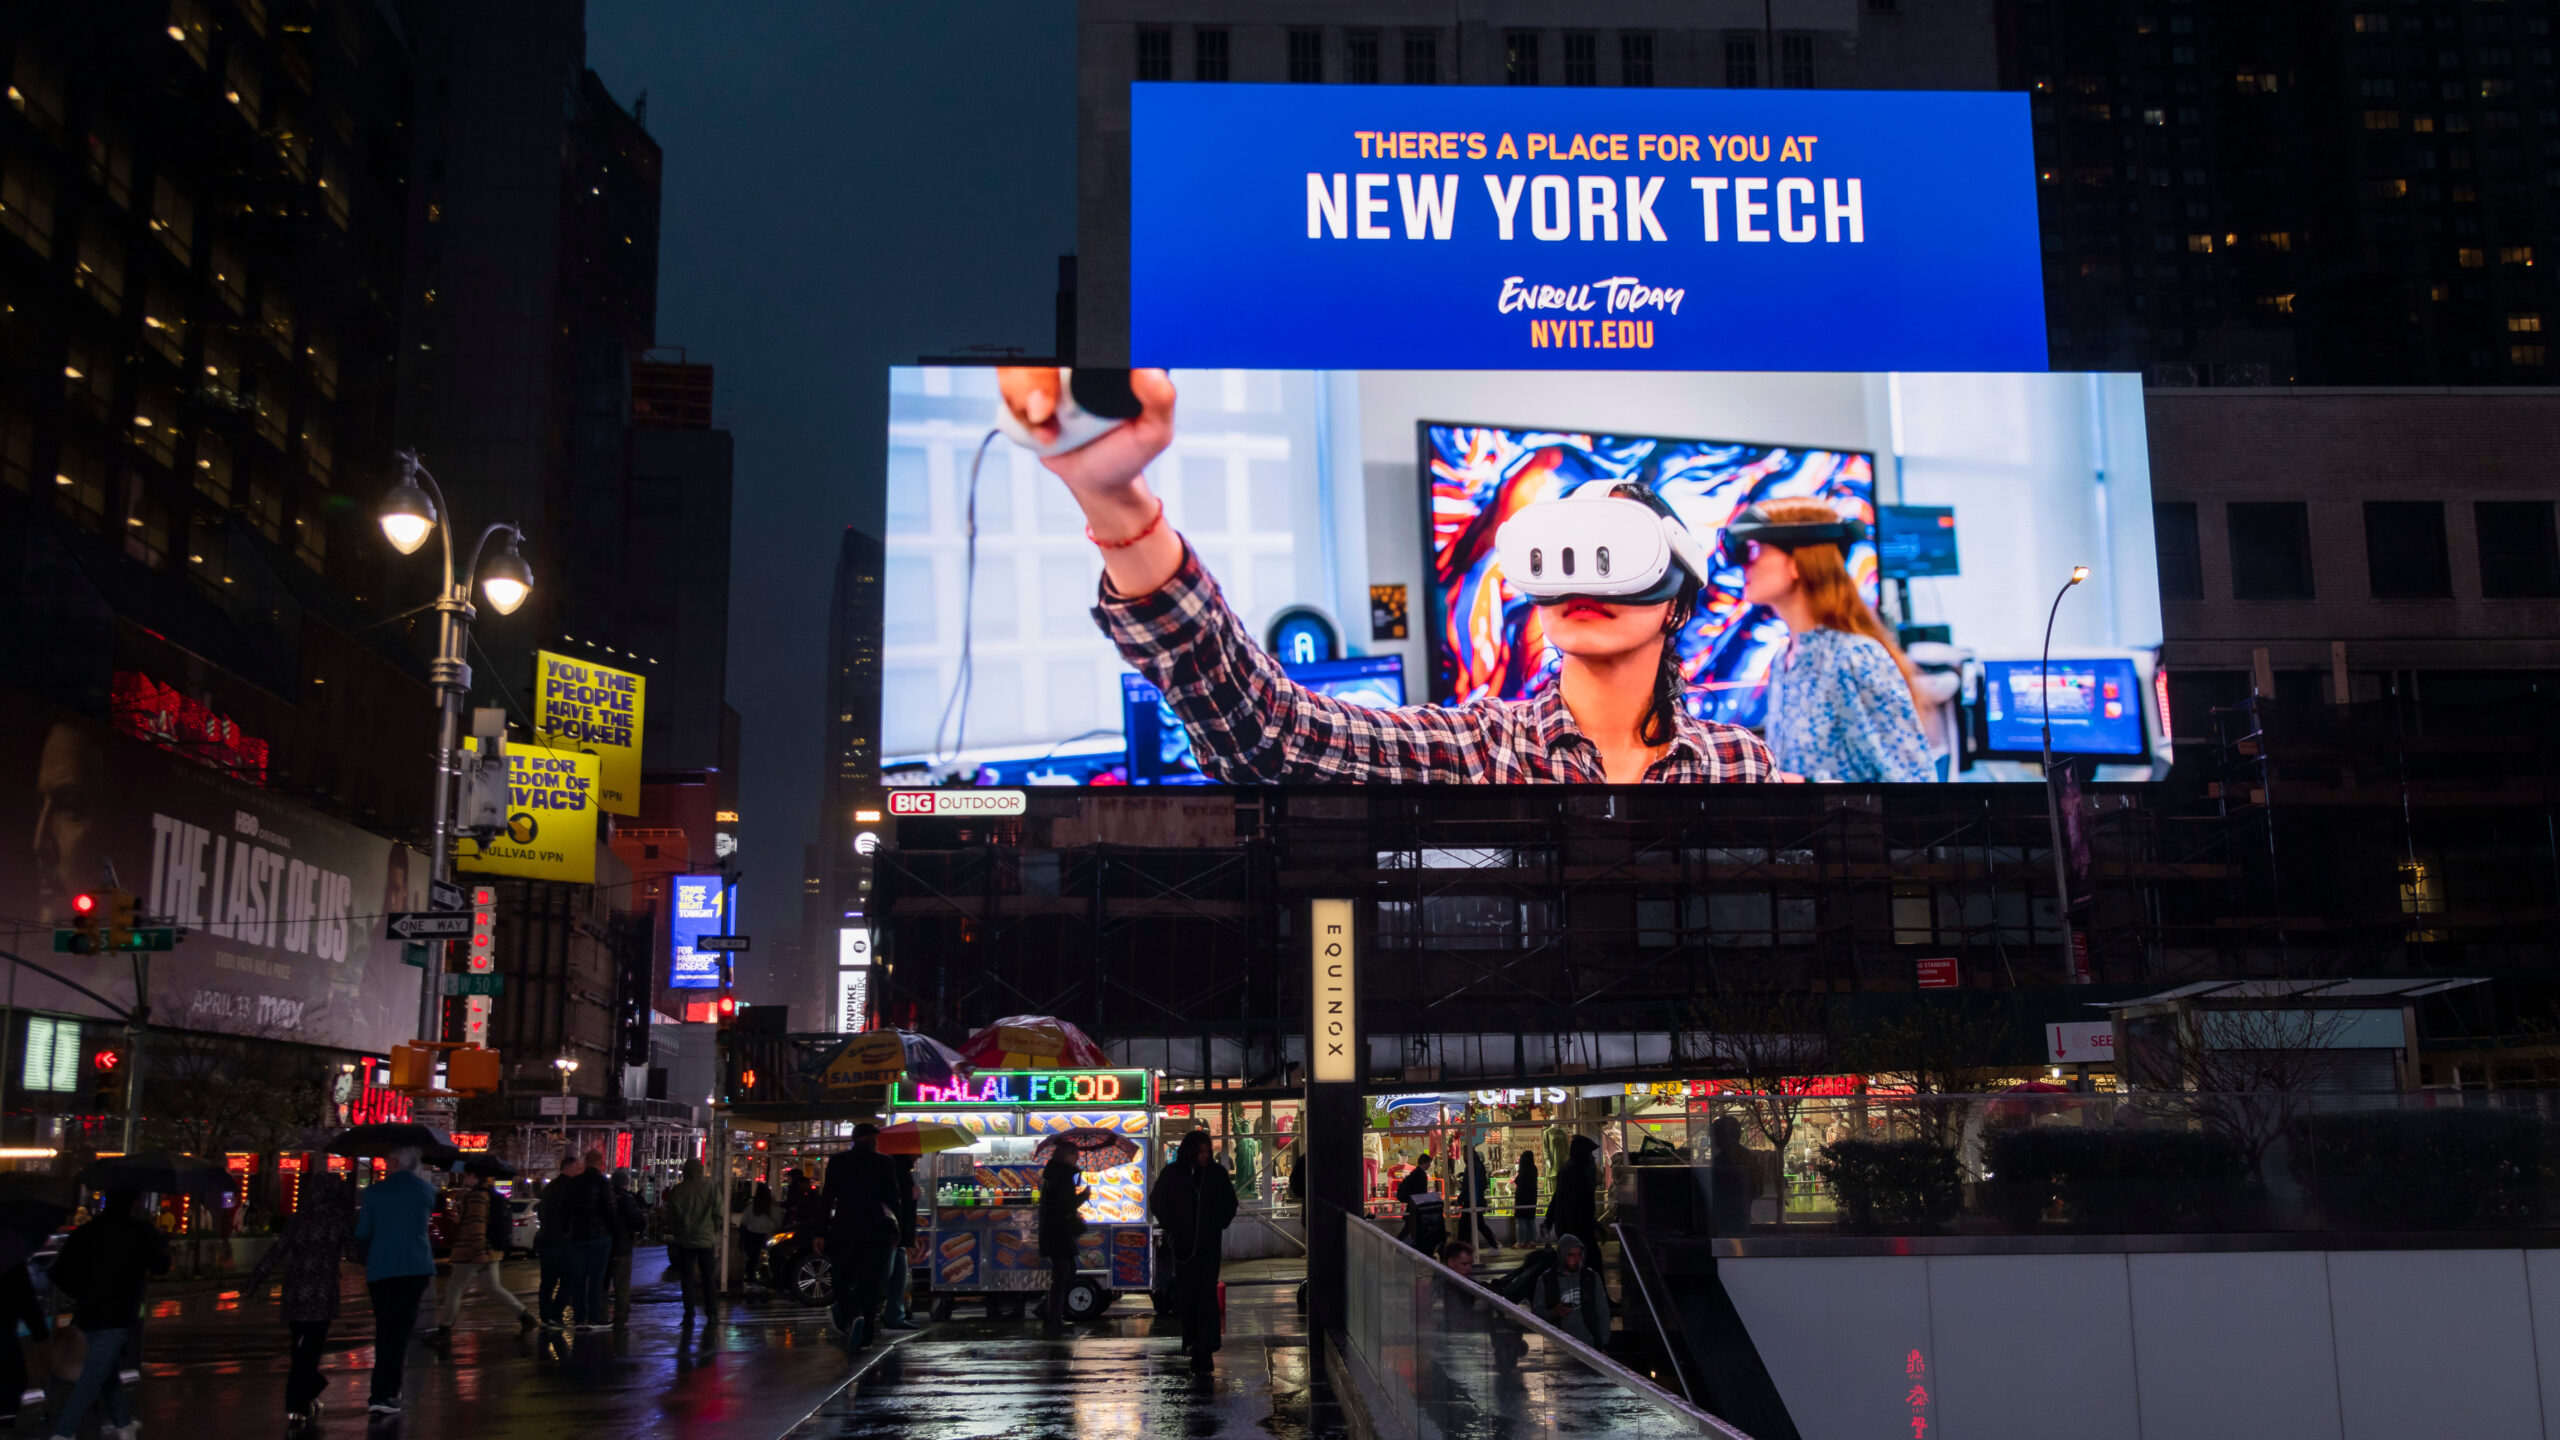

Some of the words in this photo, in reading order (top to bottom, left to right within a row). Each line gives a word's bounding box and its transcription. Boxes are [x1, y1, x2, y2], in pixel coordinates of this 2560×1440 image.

[1354, 131, 1487, 160] THERE'S
[1496, 133, 1519, 159] A
[1528, 133, 1629, 160] PLACE
[1639, 134, 1700, 161] FOR
[1708, 135, 1770, 162] YOU
[1780, 136, 1818, 162] AT
[1307, 173, 1459, 240] NEW
[1484, 175, 1668, 241] YORK
[1691, 177, 1864, 242] TECH
[1531, 320, 1654, 348] NYIT.EDU
[547, 660, 588, 682] YOU
[594, 671, 636, 693] THE
[546, 679, 634, 712] PEOPLE
[546, 700, 593, 722] HAVE
[599, 709, 634, 728] THE
[545, 716, 633, 748] POWER
[532, 758, 576, 774] FOR
[565, 776, 591, 791] OF
[602, 789, 623, 802] VPN
[896, 795, 932, 812] BIG
[939, 797, 1020, 809] OUTDOOR
[235, 810, 259, 837] HBO
[258, 827, 292, 849] ORIGINAL
[479, 846, 536, 860] MULLVAD
[540, 850, 564, 863] VPN
[149, 812, 210, 931] THE
[210, 834, 286, 948] LAST
[285, 858, 319, 954] OF
[317, 869, 351, 963] US
[400, 921, 425, 932] ONE
[437, 920, 463, 931] WAY
[460, 976, 470, 993] W
[475, 976, 490, 993] 50
[1324, 924, 1342, 1057] EQUINOX
[193, 990, 232, 1016] APRIL
[238, 995, 251, 1019] 13
[257, 995, 304, 1028] max
[831, 1068, 898, 1084] SABRETT
[1030, 1075, 1120, 1101] FOOD
